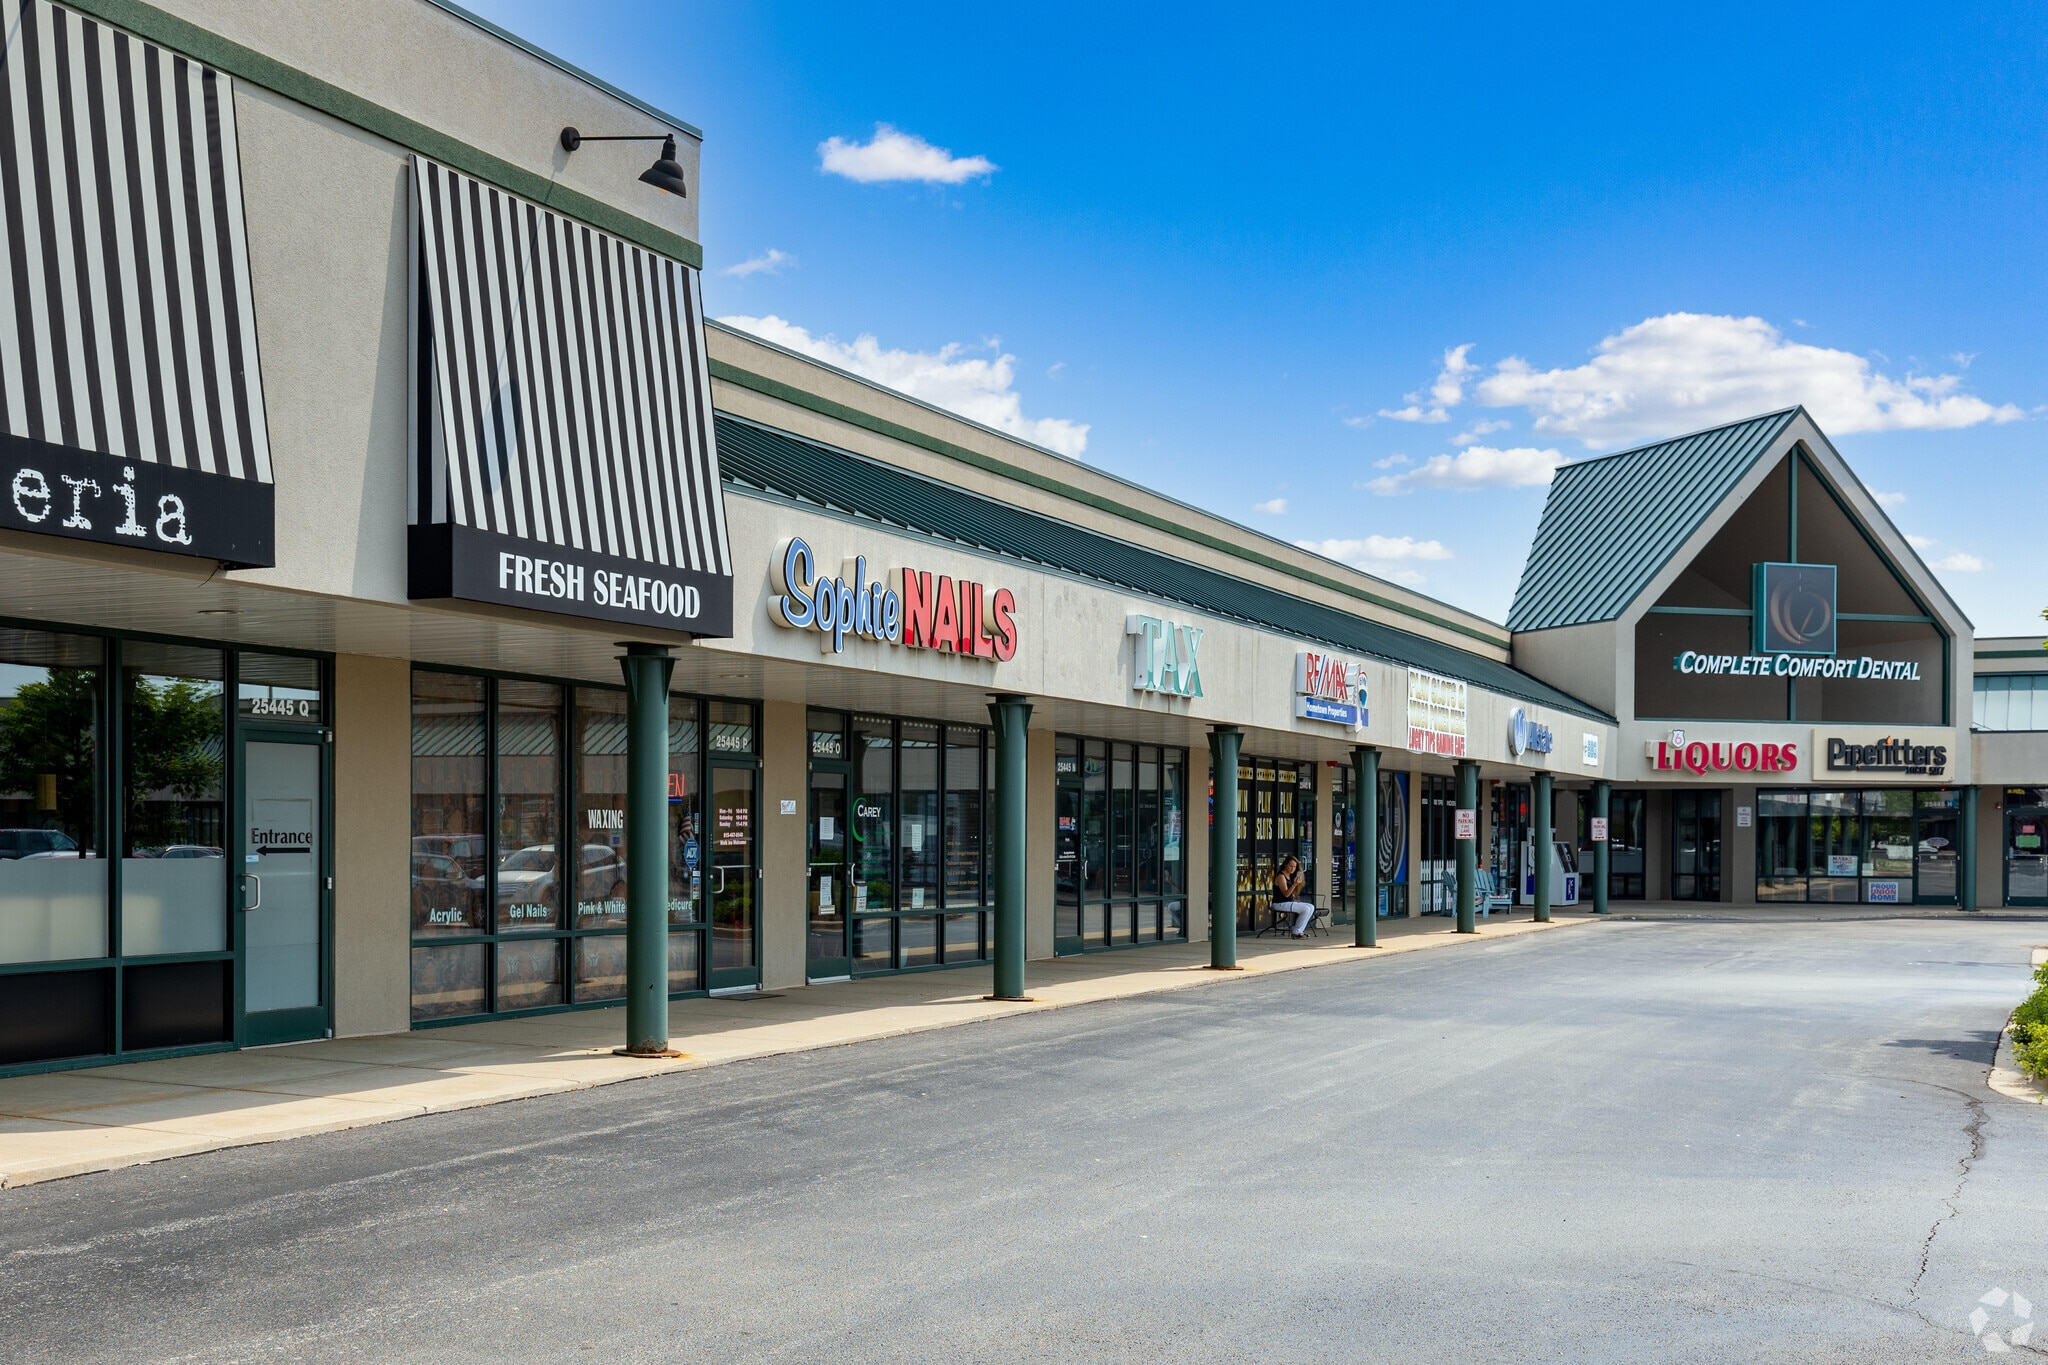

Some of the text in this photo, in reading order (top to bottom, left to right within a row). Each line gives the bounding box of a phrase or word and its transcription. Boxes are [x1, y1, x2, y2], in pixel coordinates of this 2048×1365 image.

[499, 551, 700, 619] FRESH SEAFOOD
[781, 536, 1018, 662] Sophie NAILS
[1137, 613, 1204, 698] TAX
[1679, 650, 1921, 681] COMPLETE COMFORT DENTAL
[1305, 652, 1349, 700] RE/MAX
[1409, 671, 1431, 701] PLAY
[252, 698, 309, 718] 25445 Q
[1327, 705, 1348, 719] Properties
[716, 735, 748, 750] 25445 P
[813, 741, 833, 754] 25445
[1674, 733, 1682, 745] 6
[1827, 736, 1947, 771] Pipefitters
[668, 773, 685, 797] EN
[857, 805, 882, 818] CAREY
[1258, 791, 1272, 814] PLAY
[1279, 791, 1293, 814] PLAY
[587, 809, 624, 829] WAXING
[1256, 817, 1273, 840] SLOTS
[251, 828, 313, 844] Entrance
[509, 903, 548, 918] Gel Nails
[578, 900, 626, 915] Pink & White
[667, 898, 694, 912] edicure
[429, 907, 463, 925] Acrylic
